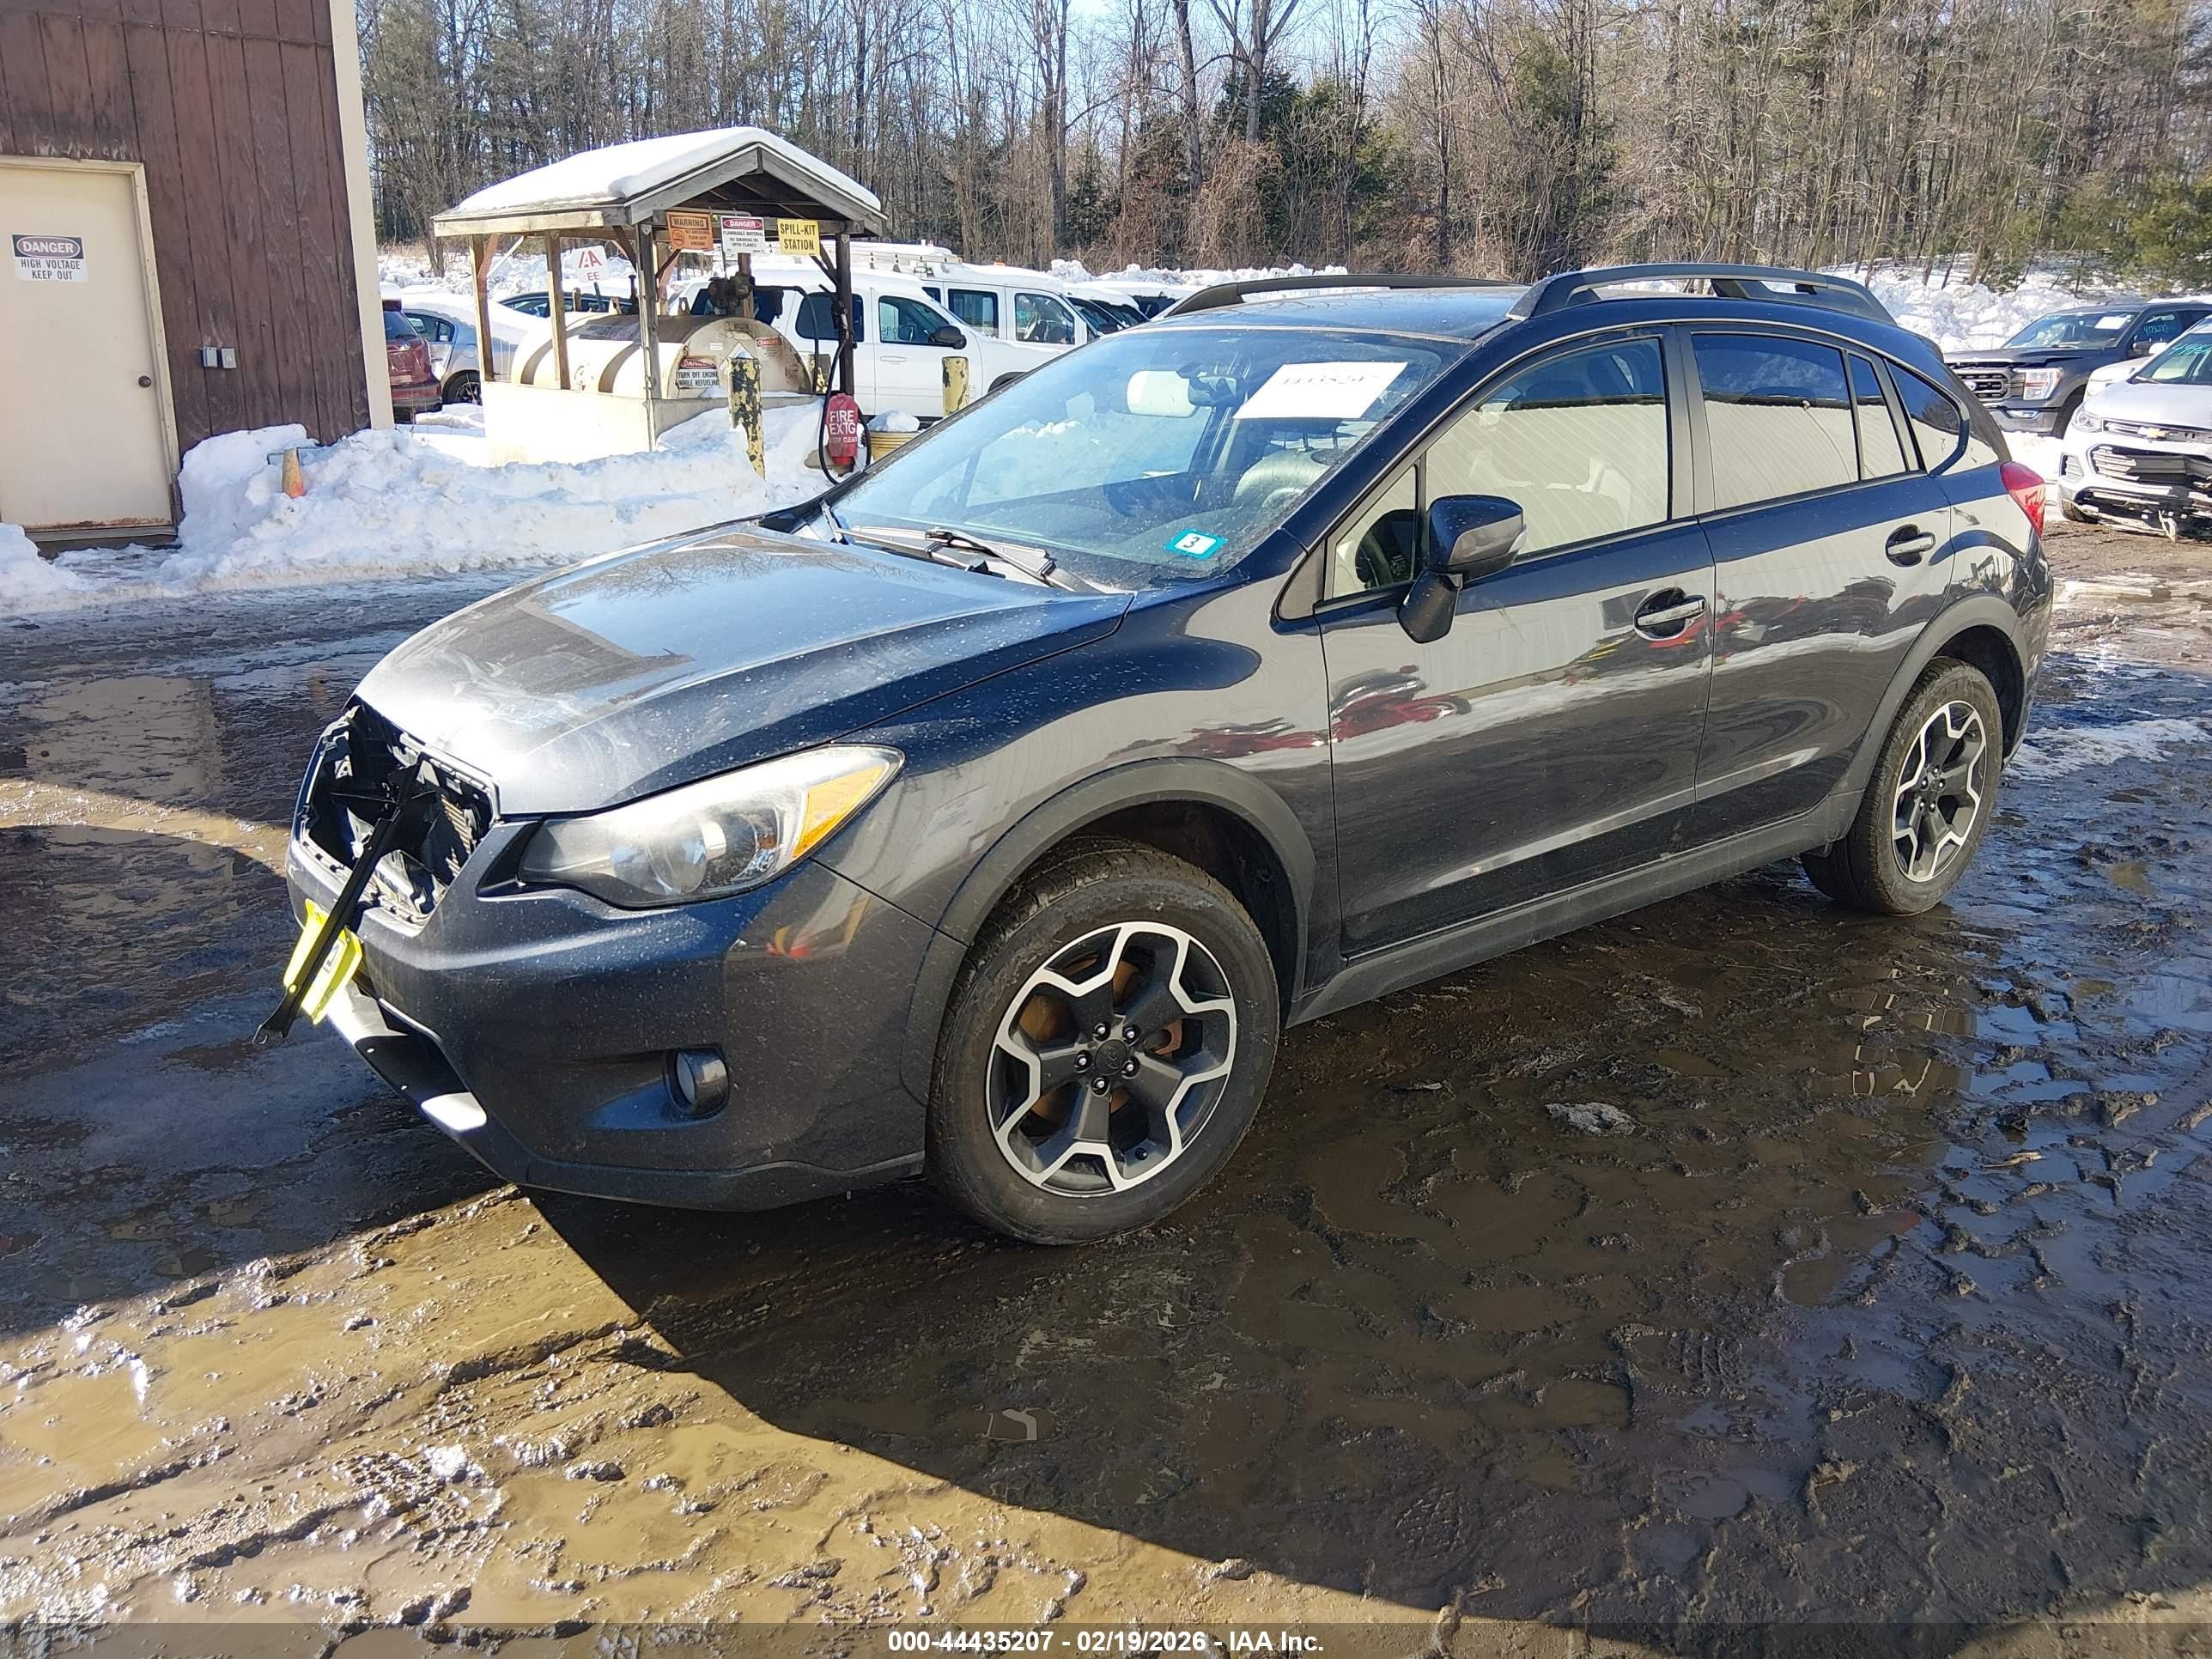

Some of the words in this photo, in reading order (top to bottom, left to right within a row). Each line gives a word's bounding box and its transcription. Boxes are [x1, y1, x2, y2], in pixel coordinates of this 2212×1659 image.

[672, 217, 705, 228] WARNING
[729, 219, 756, 228] DANGER
[780, 223, 816, 235] SPILL-KIT
[22, 240, 74, 253] DANGER
[784, 239, 815, 250] STATION
[21, 258, 41, 268] HIGH
[46, 259, 81, 270] VOLTAGE
[32, 270, 52, 279] KEEP
[57, 270, 72, 280] OUT
[830, 410, 854, 422] FIRE
[829, 422, 856, 434] EXTG
[1182, 536, 1200, 549] 3
